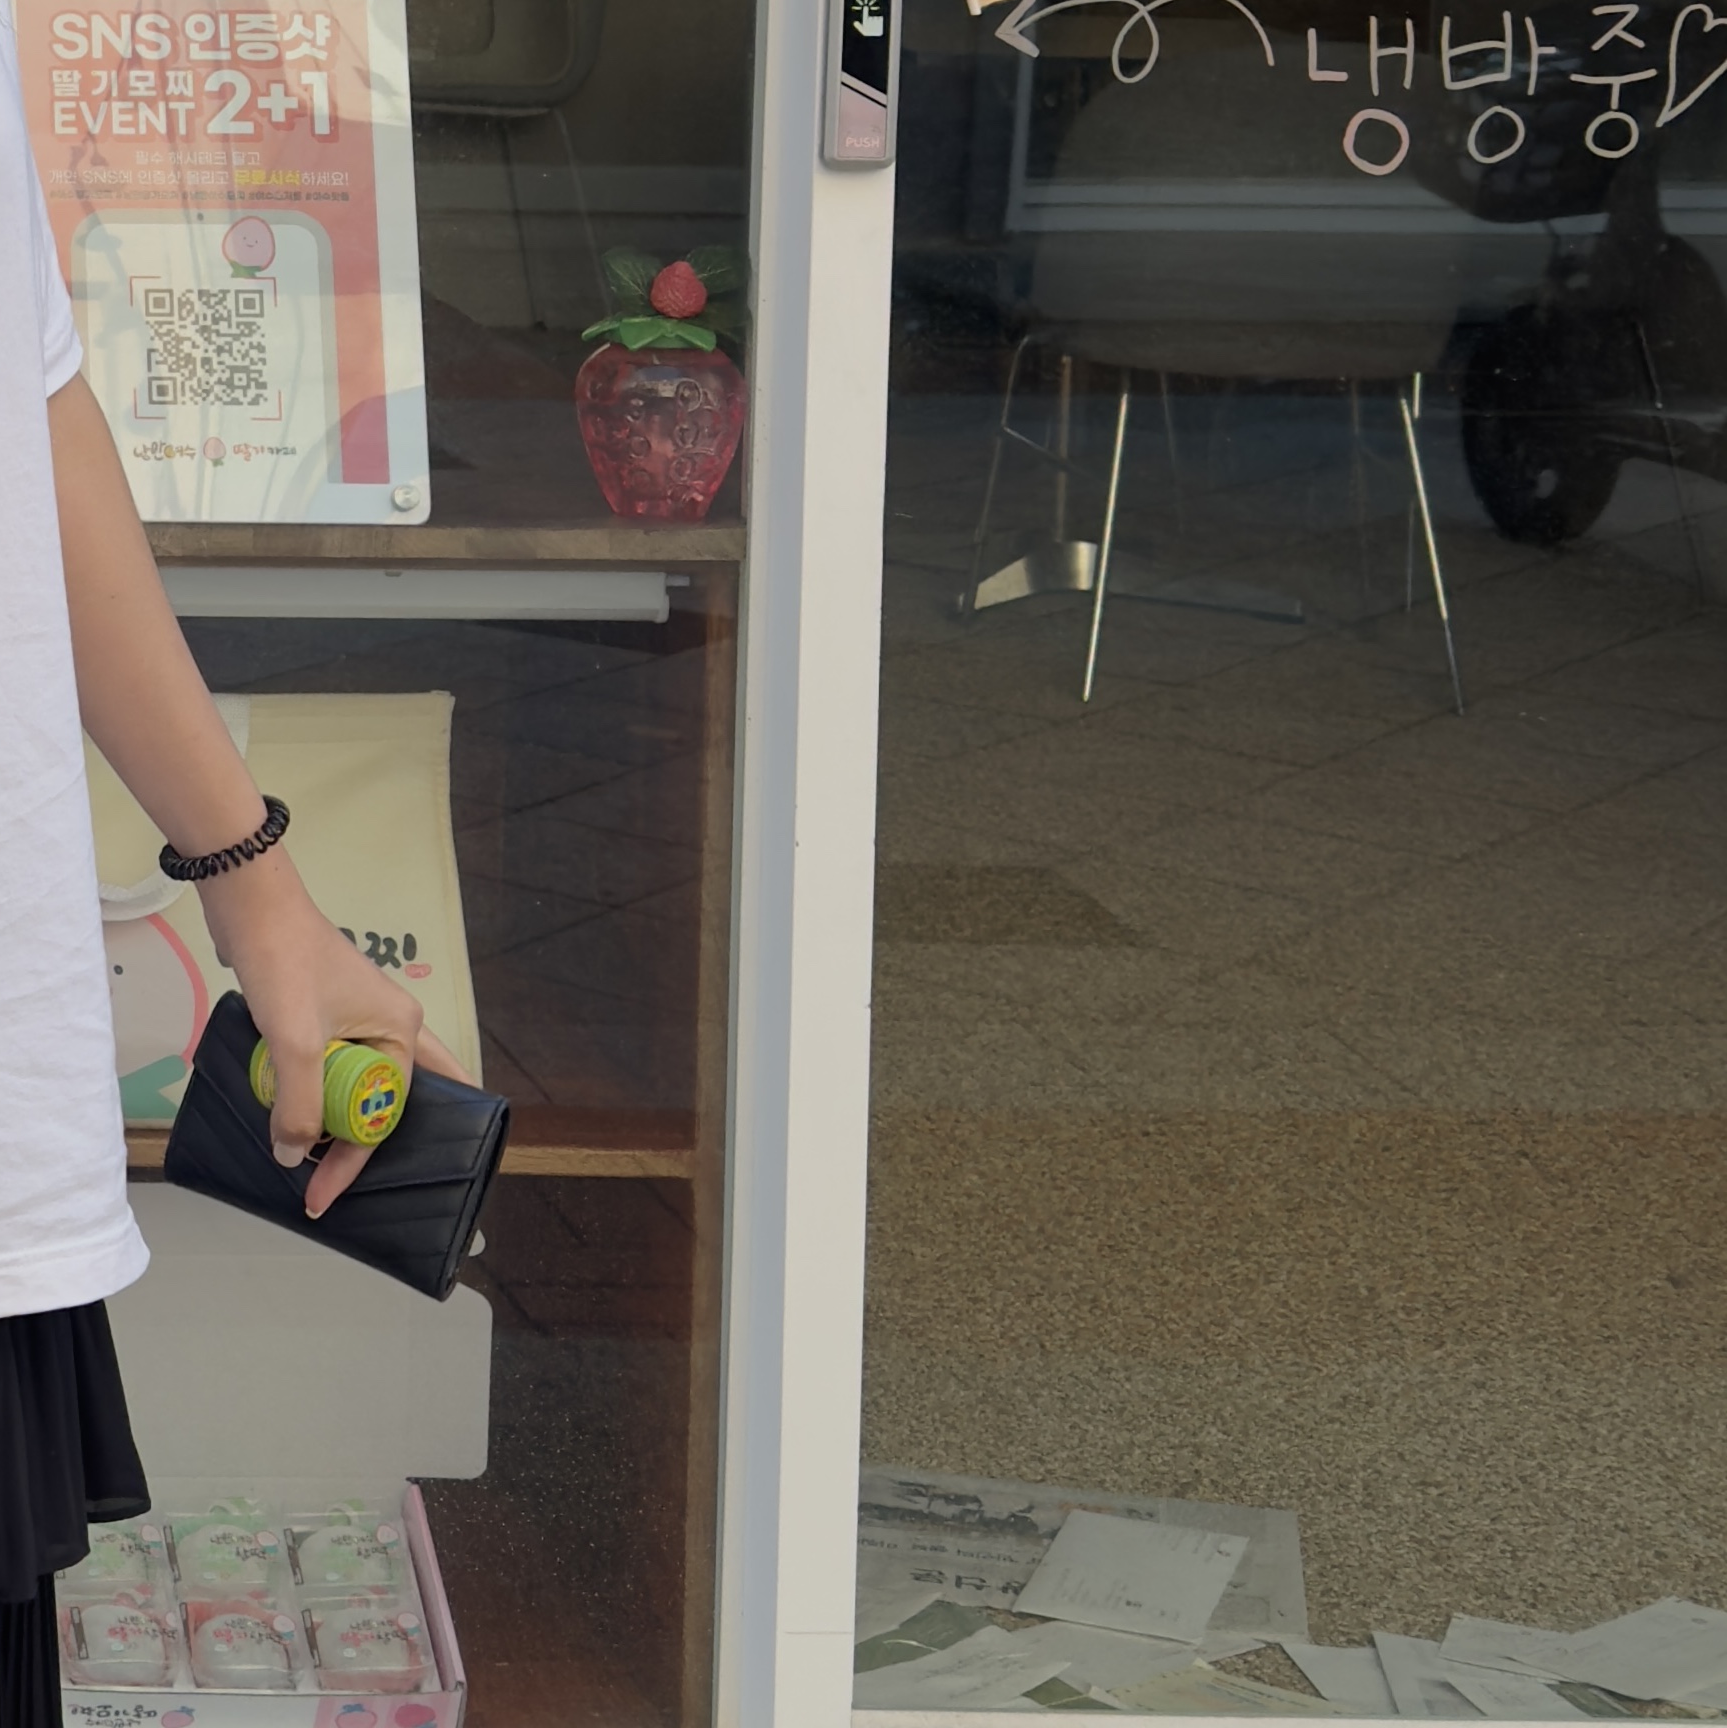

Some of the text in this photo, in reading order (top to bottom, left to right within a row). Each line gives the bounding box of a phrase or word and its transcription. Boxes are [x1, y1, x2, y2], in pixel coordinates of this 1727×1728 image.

[52, 13, 332, 62] SNS 인증샷
[204, 69, 331, 135] 2+1
[1307, 4, 1657, 176] 냉방중
[53, 101, 195, 135] EVENT
[845, 135, 880, 148] PUSH
